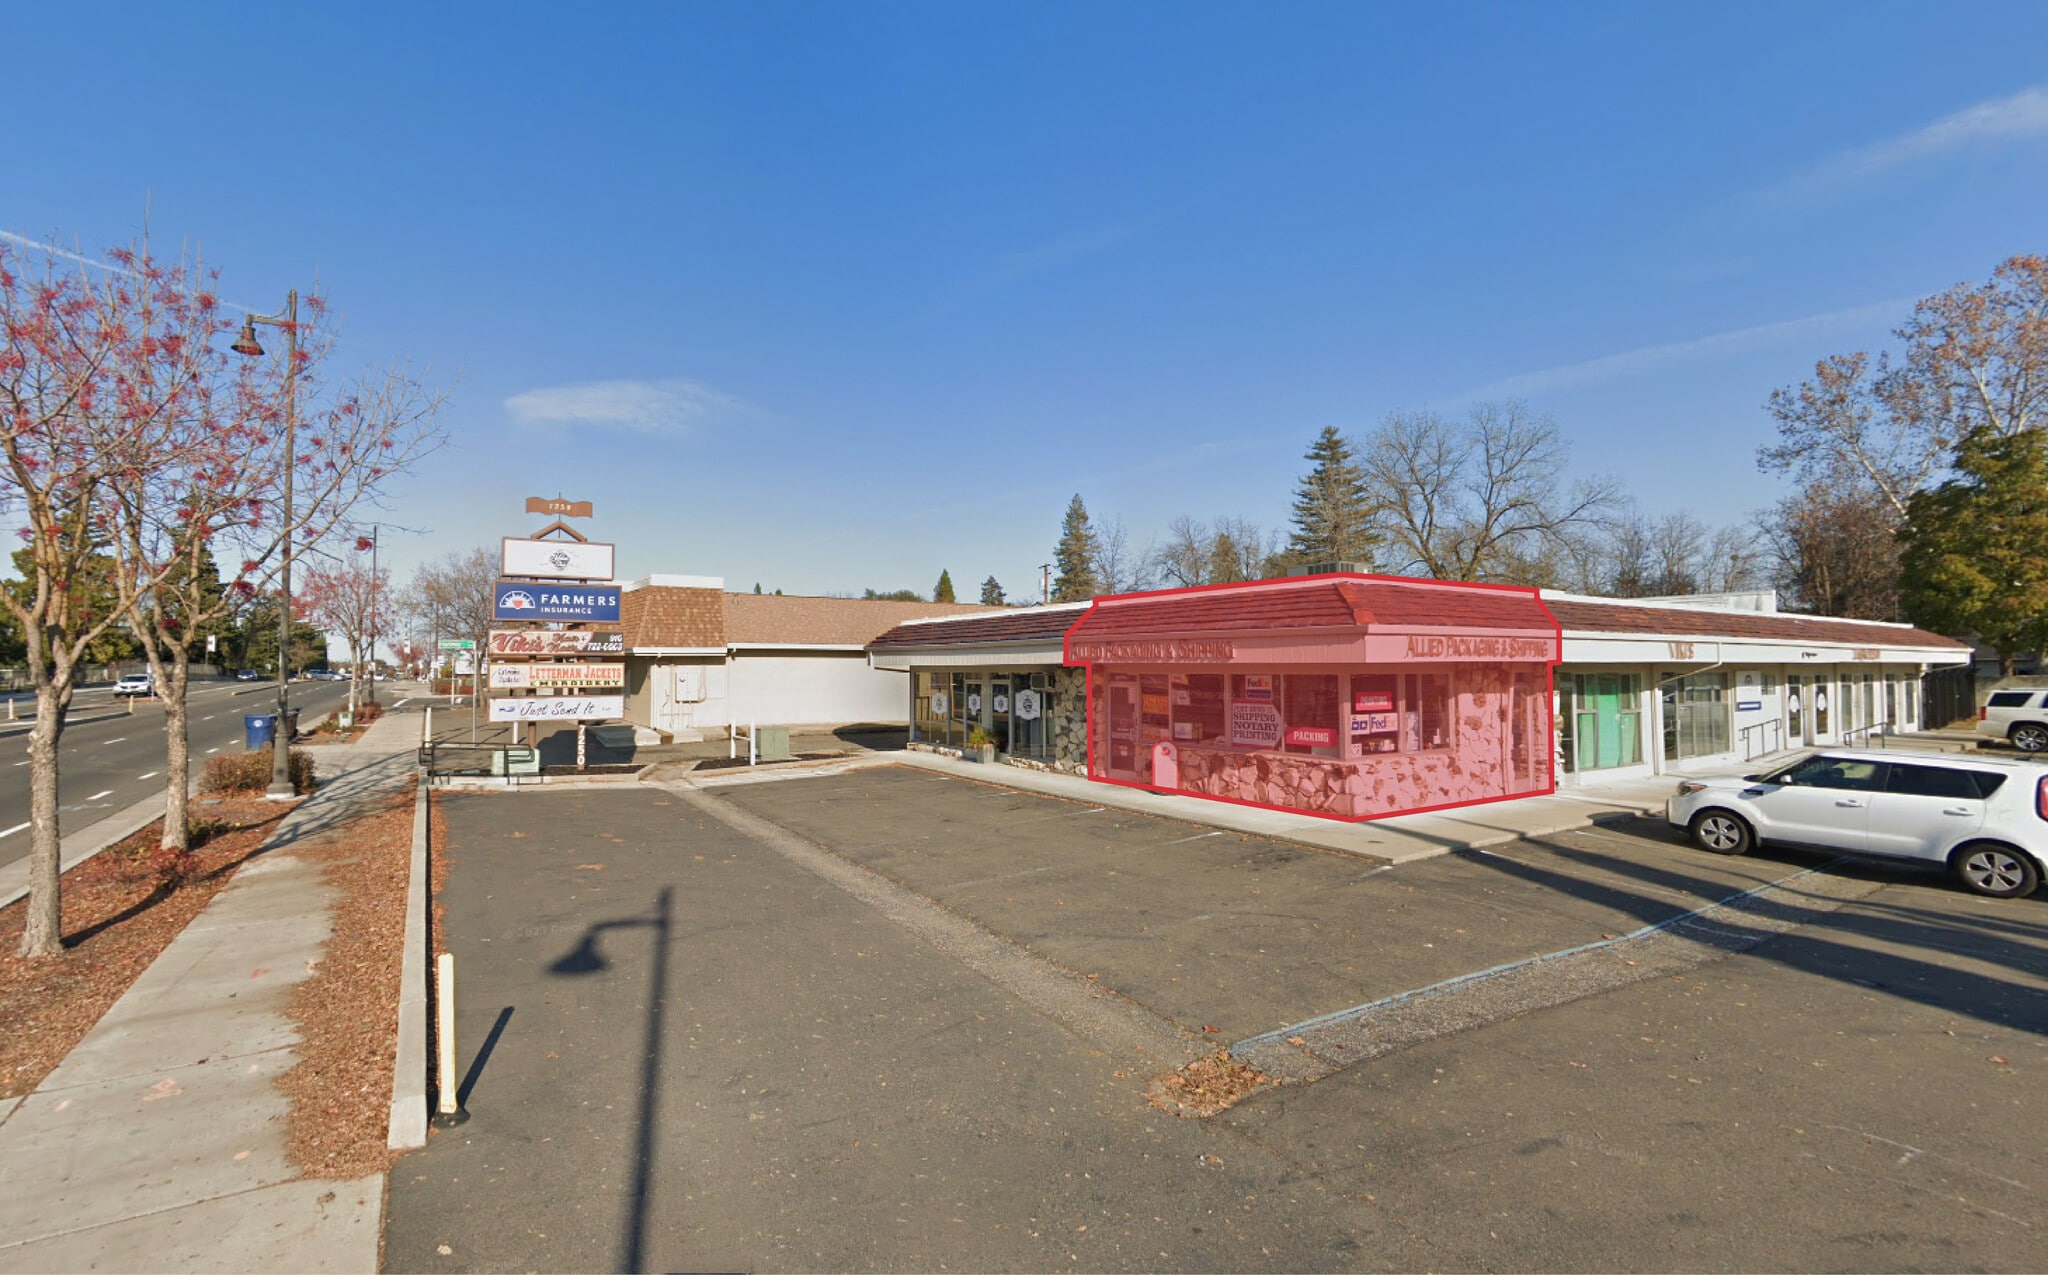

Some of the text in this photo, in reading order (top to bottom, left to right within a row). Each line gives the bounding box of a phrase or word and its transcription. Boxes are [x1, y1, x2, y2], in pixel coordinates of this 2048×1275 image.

[540, 594, 617, 606] FARMERS
[540, 607, 593, 615] INSURANCE
[1406, 635, 1443, 658] ALLIED
[1446, 635, 1499, 658] PACKAGING
[1508, 637, 1548, 659] SHIPPING
[529, 664, 621, 679] LETTERMAN JACKETS
[520, 702, 549, 716] Just
[551, 702, 580, 716] Send
[583, 701, 595, 715] It
[1234, 712, 1275, 722] SHIPPING
[1233, 722, 1279, 731] NOTARY
[1233, 730, 1277, 740] PRINTING
[1293, 731, 1329, 742] PACKING
[577, 725, 586, 765] 7250
